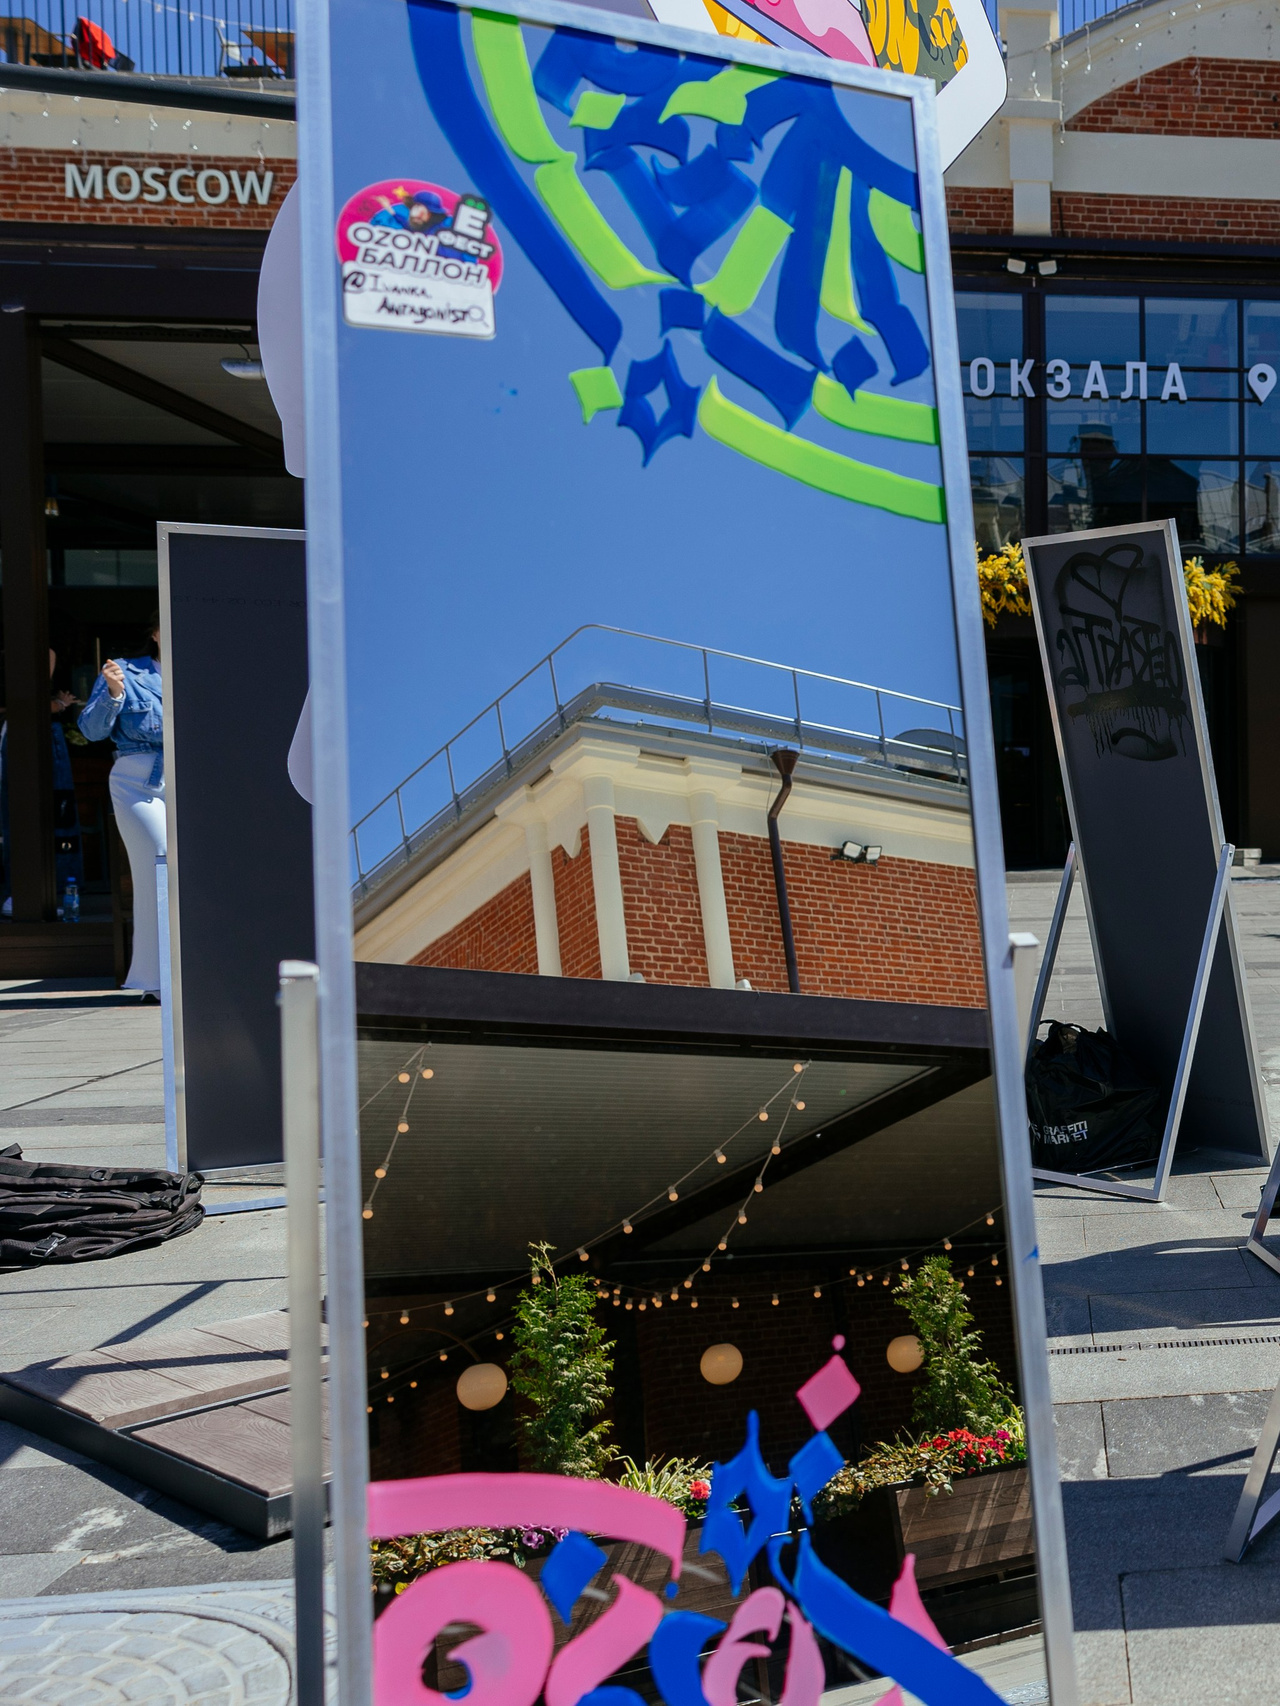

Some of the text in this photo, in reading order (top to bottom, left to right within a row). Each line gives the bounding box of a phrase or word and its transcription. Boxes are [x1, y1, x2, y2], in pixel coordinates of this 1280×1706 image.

[64, 163, 274, 205] MOSCOW
[353, 226, 434, 255] OZON
[437, 230, 494, 258] ФЕСТ
[362, 248, 483, 284] БАЛЛОН
[1043, 1120, 1088, 1136] GRAFFITI
